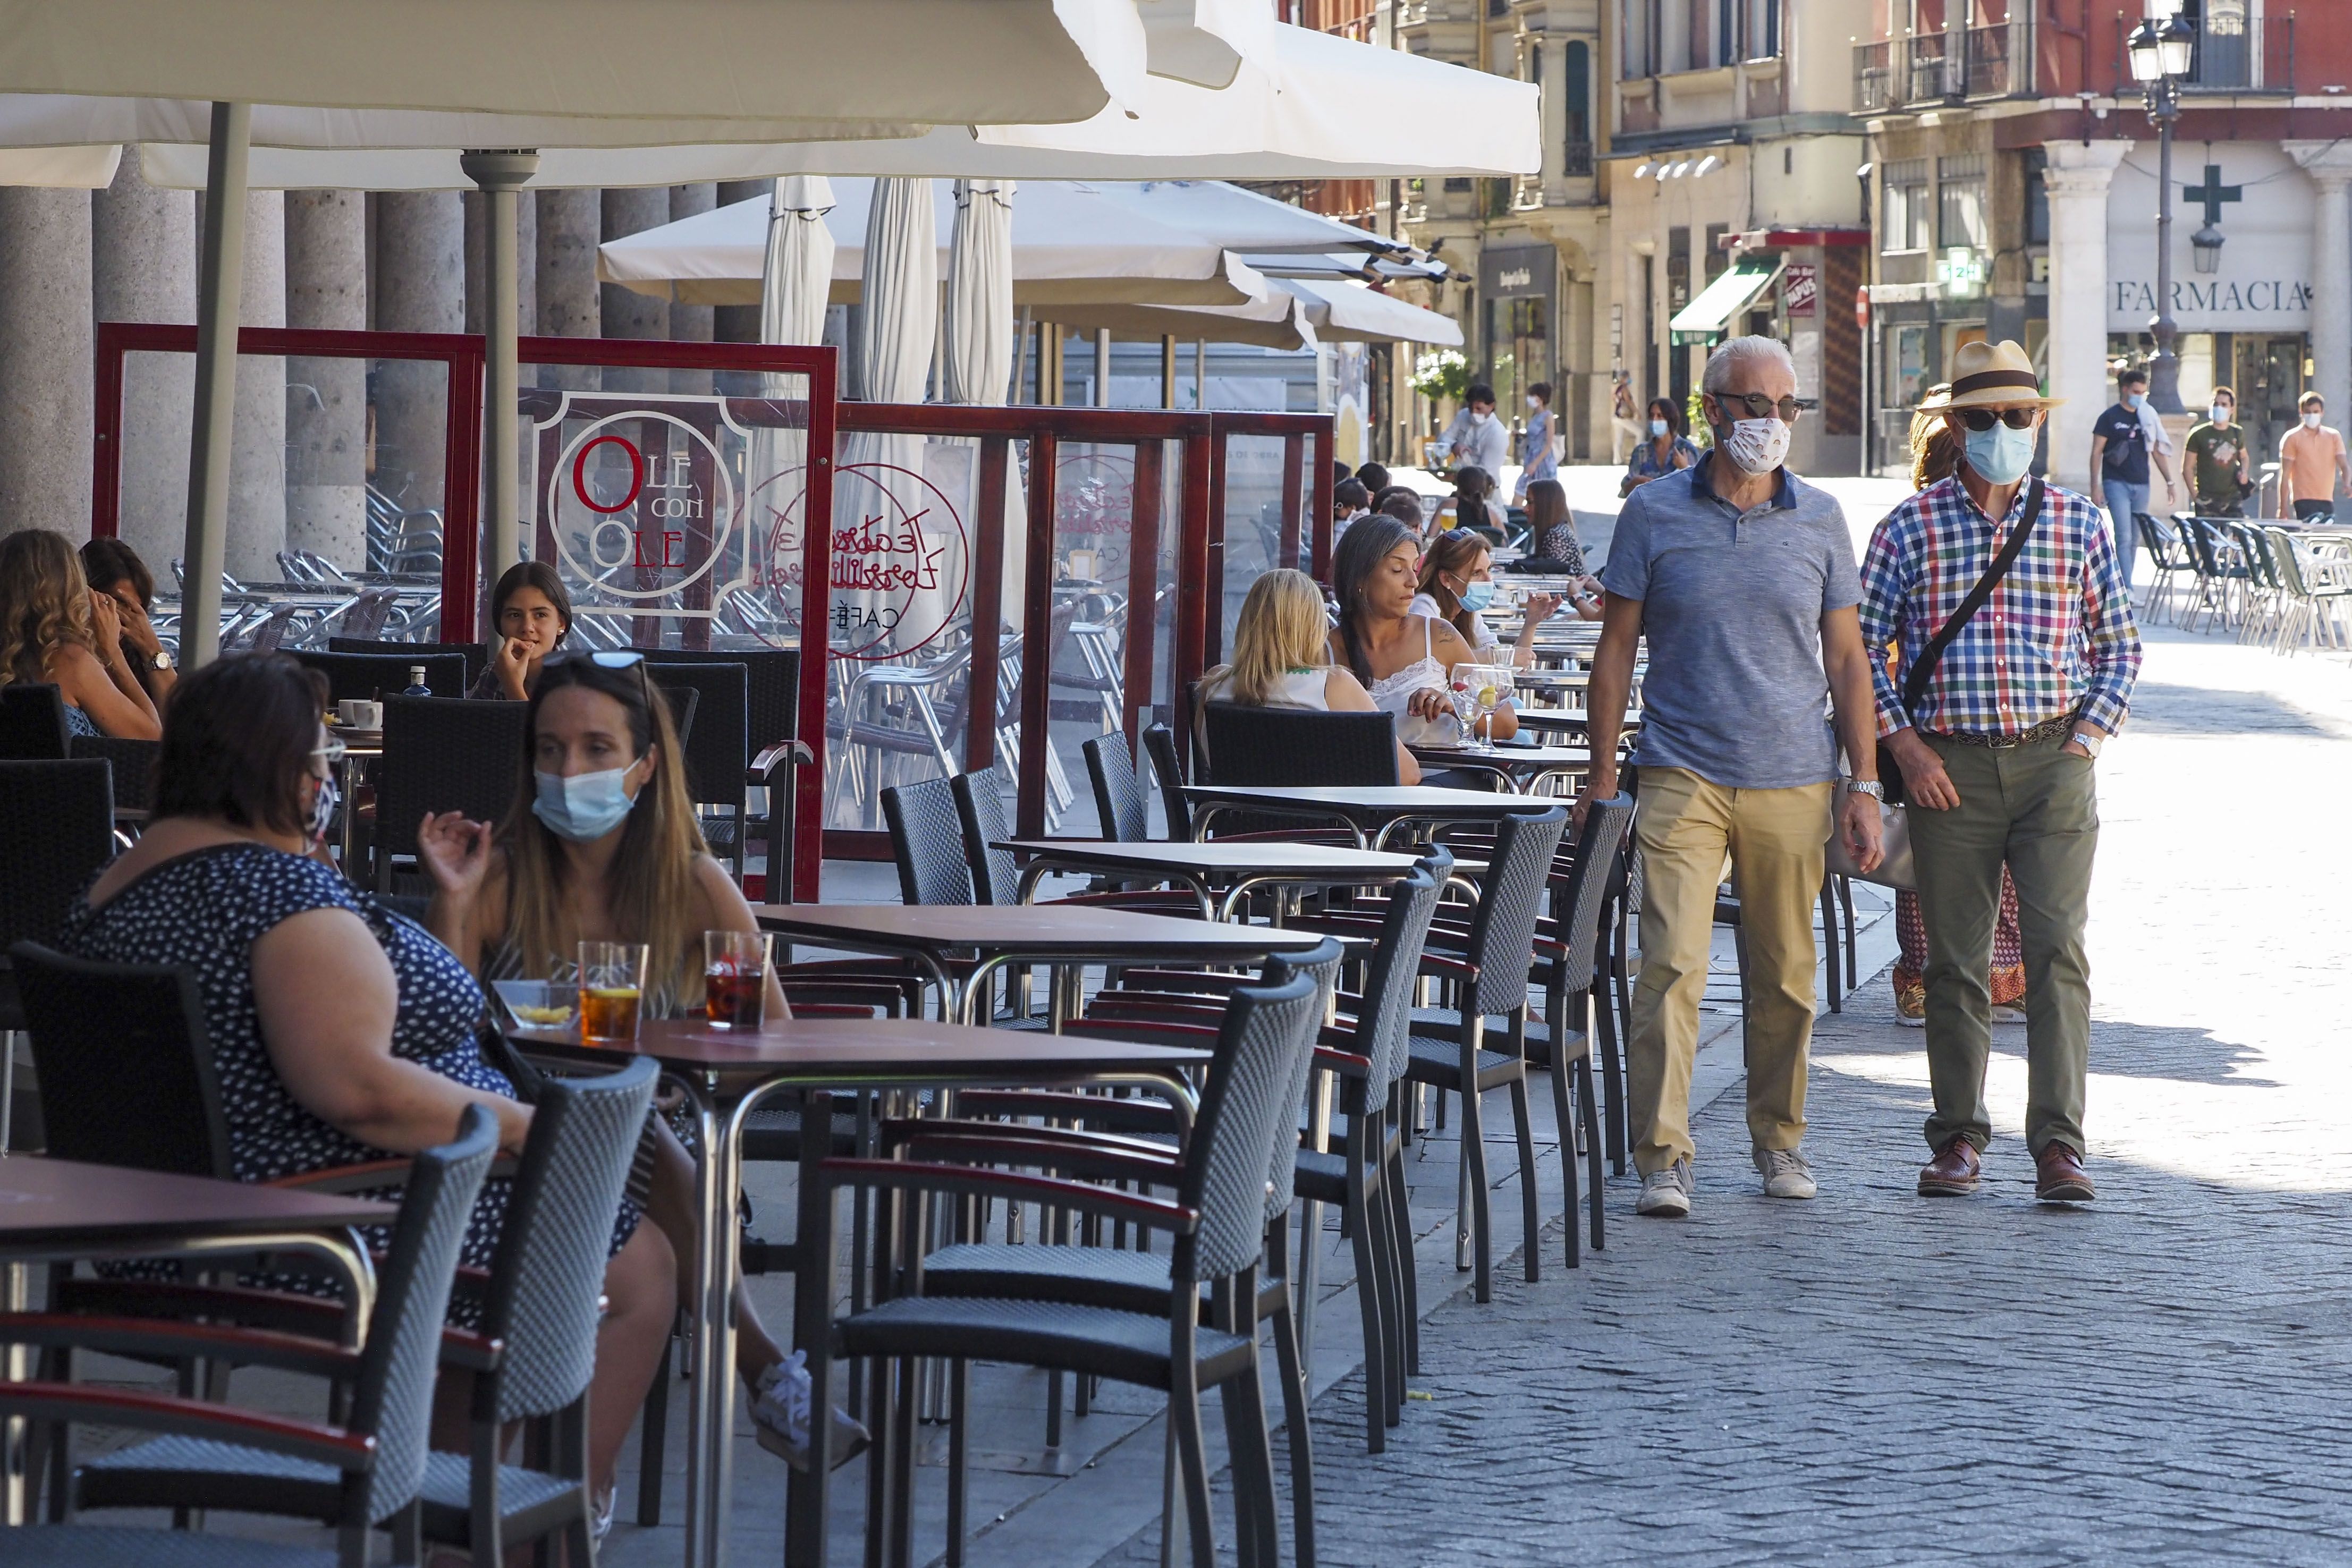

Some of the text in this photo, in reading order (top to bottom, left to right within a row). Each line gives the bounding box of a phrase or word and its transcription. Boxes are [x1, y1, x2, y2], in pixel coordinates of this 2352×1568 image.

[2116, 281, 2311, 312] FARMACIA
[572, 435, 693, 514] OLE
[650, 497, 704, 519] CON
[589, 520, 686, 568] OLE
